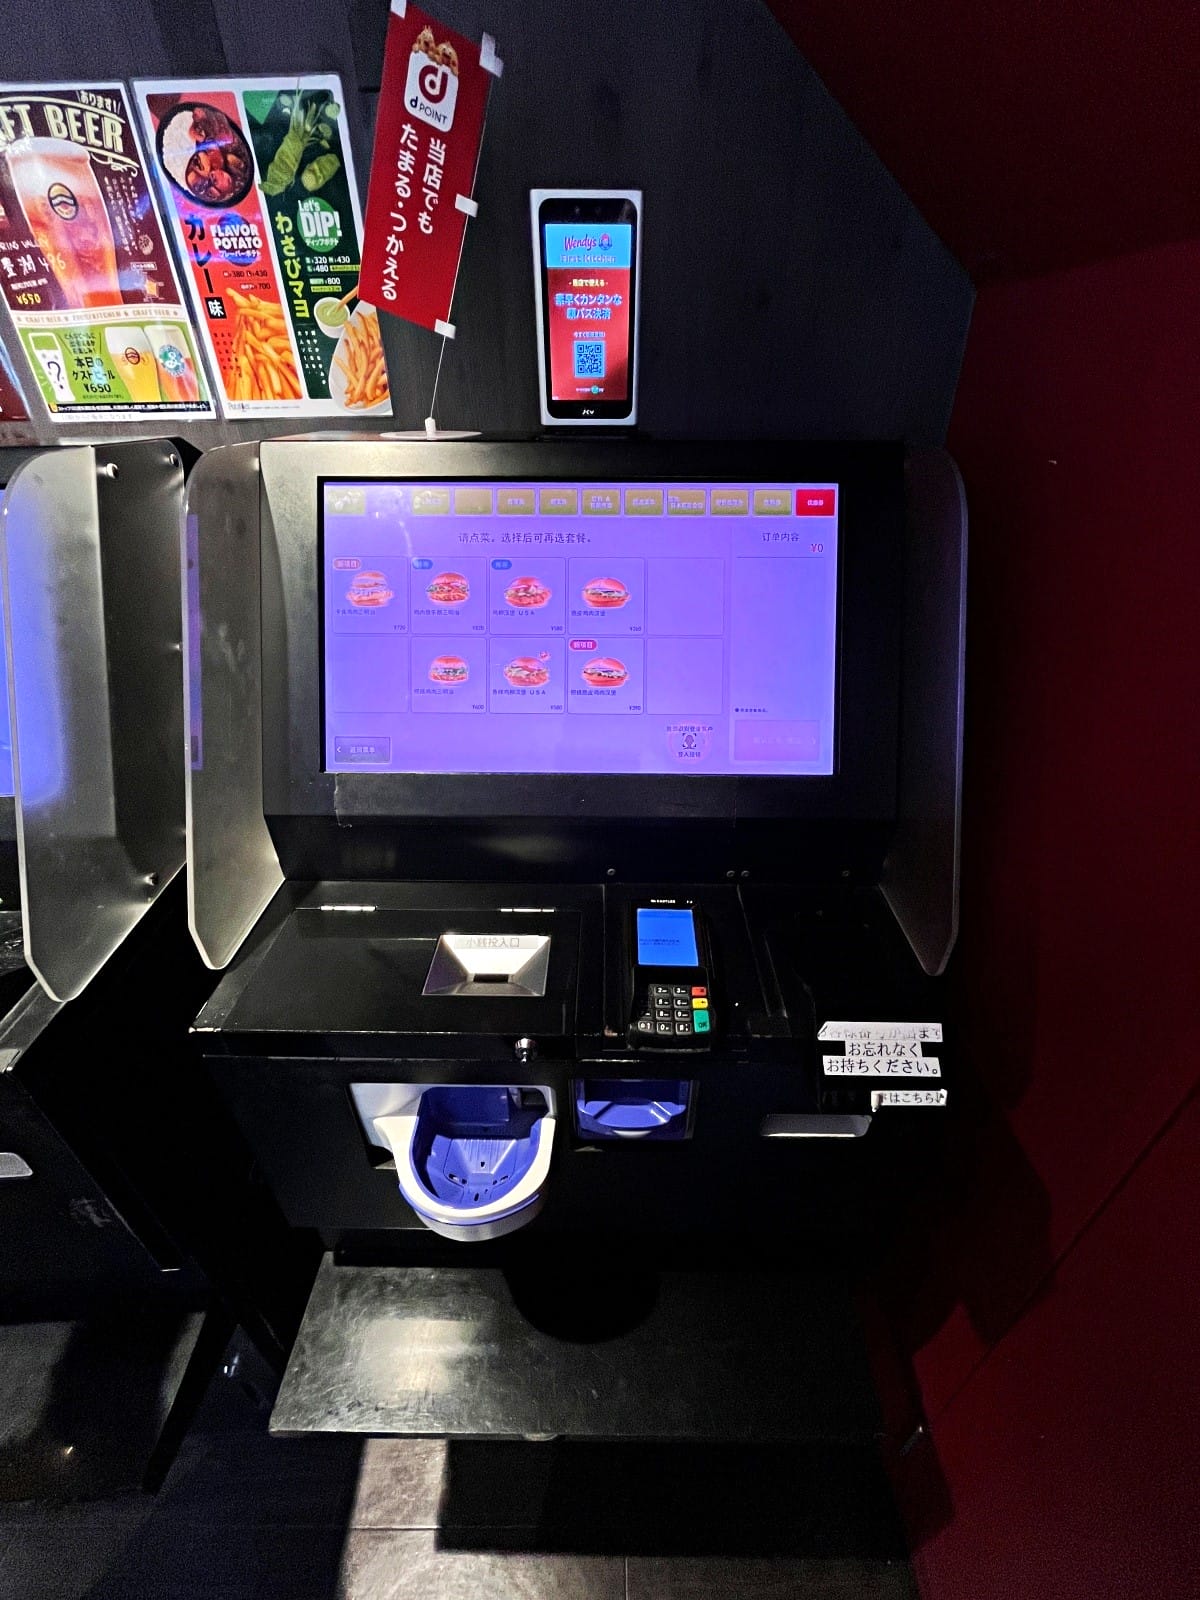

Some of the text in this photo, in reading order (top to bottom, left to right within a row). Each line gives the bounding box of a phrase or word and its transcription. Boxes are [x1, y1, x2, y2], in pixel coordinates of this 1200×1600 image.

[419, 102, 448, 125] POINT
[0, 104, 124, 153] FT BEER
[417, 137, 447, 236] 当店でも
[298, 200, 320, 211] Let's
[381, 123, 419, 302] たまる・つかえる
[210, 224, 259, 237] FLAVOR
[300, 211, 342, 238] DIP!
[213, 236, 263, 250] POTATO
[564, 236, 598, 252] Wendy's
[275, 211, 310, 318] わさびマヨ
[74, 356, 104, 368] 本日の
[83, 383, 112, 393] ¥650
[762, 532, 800, 542] 订单内容
[848, 1042, 919, 1057] お忘れなく
[826, 1059, 938, 1075] お持ちください。
